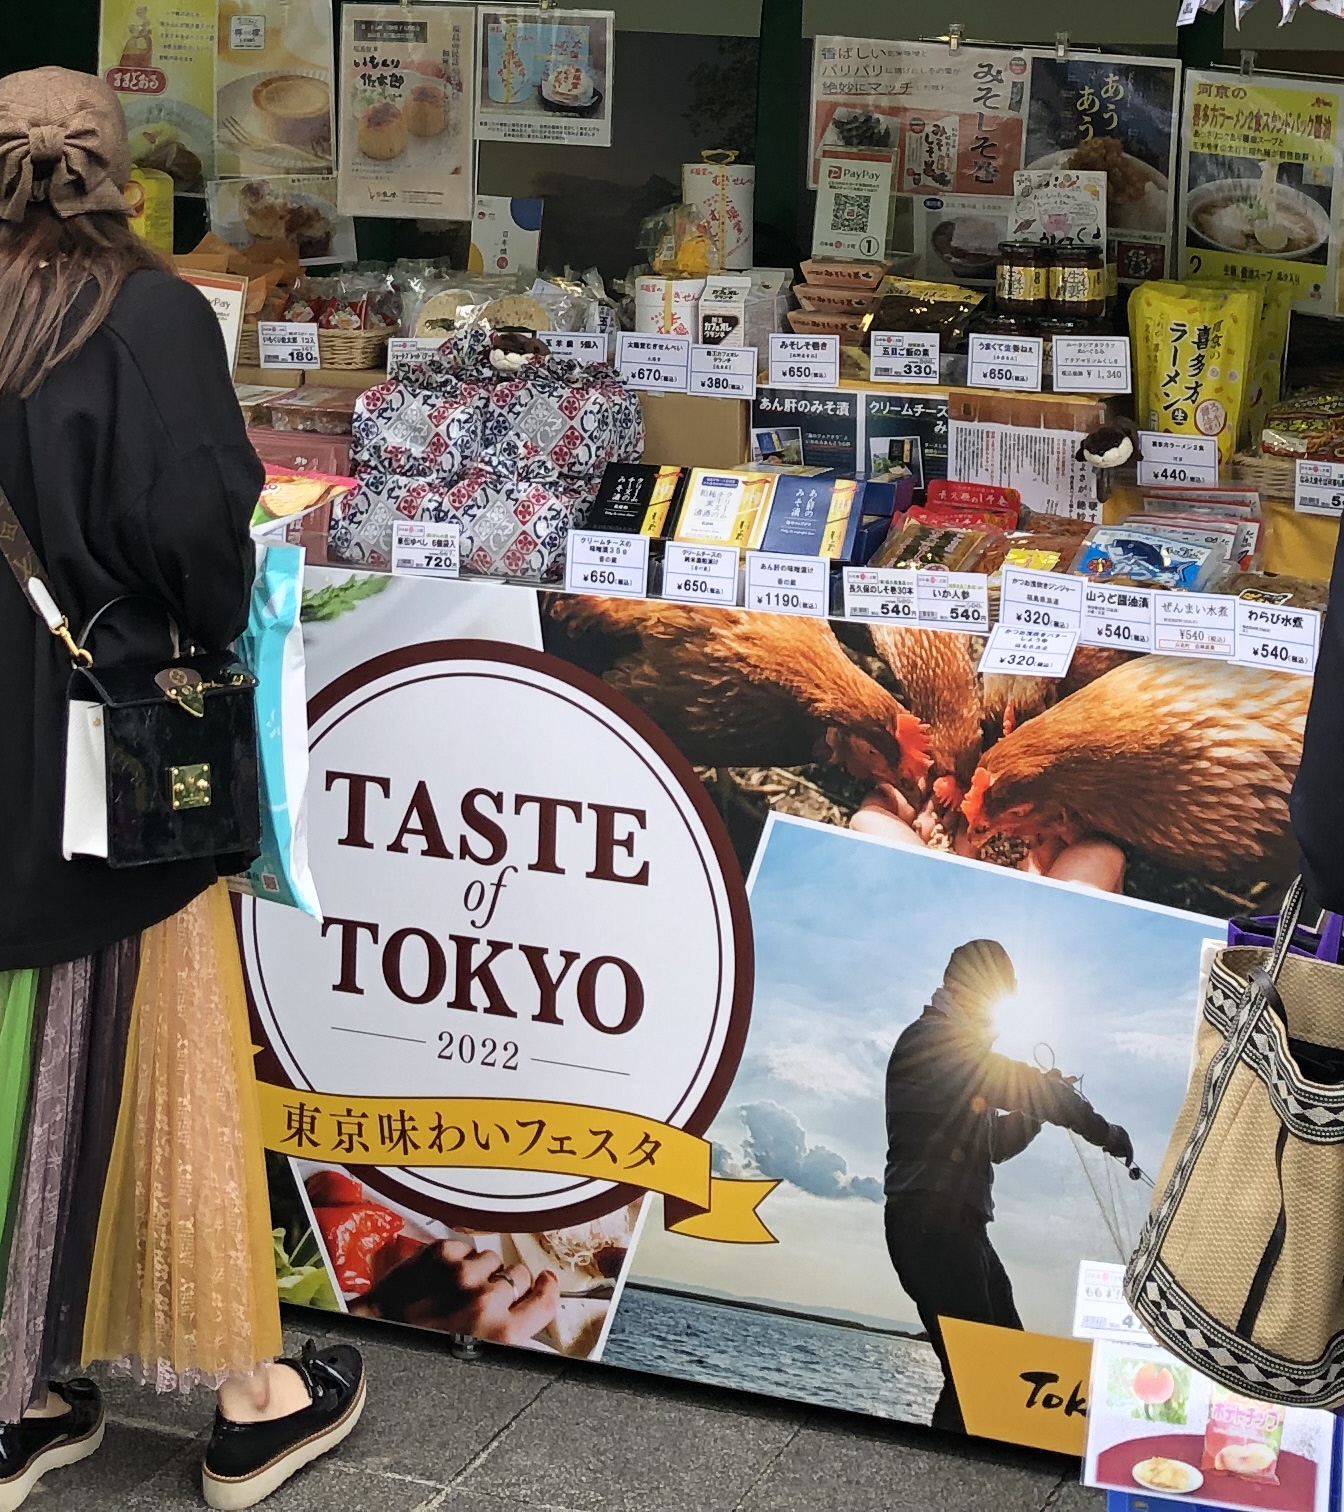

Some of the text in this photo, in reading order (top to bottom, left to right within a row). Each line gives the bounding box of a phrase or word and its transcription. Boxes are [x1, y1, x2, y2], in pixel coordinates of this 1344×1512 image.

[843, 168, 880, 181] PayPay
[780, 341, 828, 351] みそしそ巻き
[1161, 322, 1189, 411] ラーメン
[1182, 325, 1211, 404] 喜多方
[759, 397, 849, 416] あん肝のみそ漬
[580, 537, 632, 548] クリームチーズの
[849, 584, 914, 595] 長久保のしそ巻30本
[932, 589, 970, 600] いか人参
[1161, 601, 1229, 618] ぜんまい水煮
[1248, 609, 1304, 629] わらび水煮
[325, 770, 652, 888] TASTE
[463, 865, 519, 930] of
[321, 916, 645, 1037] TOKYO
[436, 1030, 521, 1072] 2022
[279, 1101, 664, 1170] 東京味わいフェスタ
